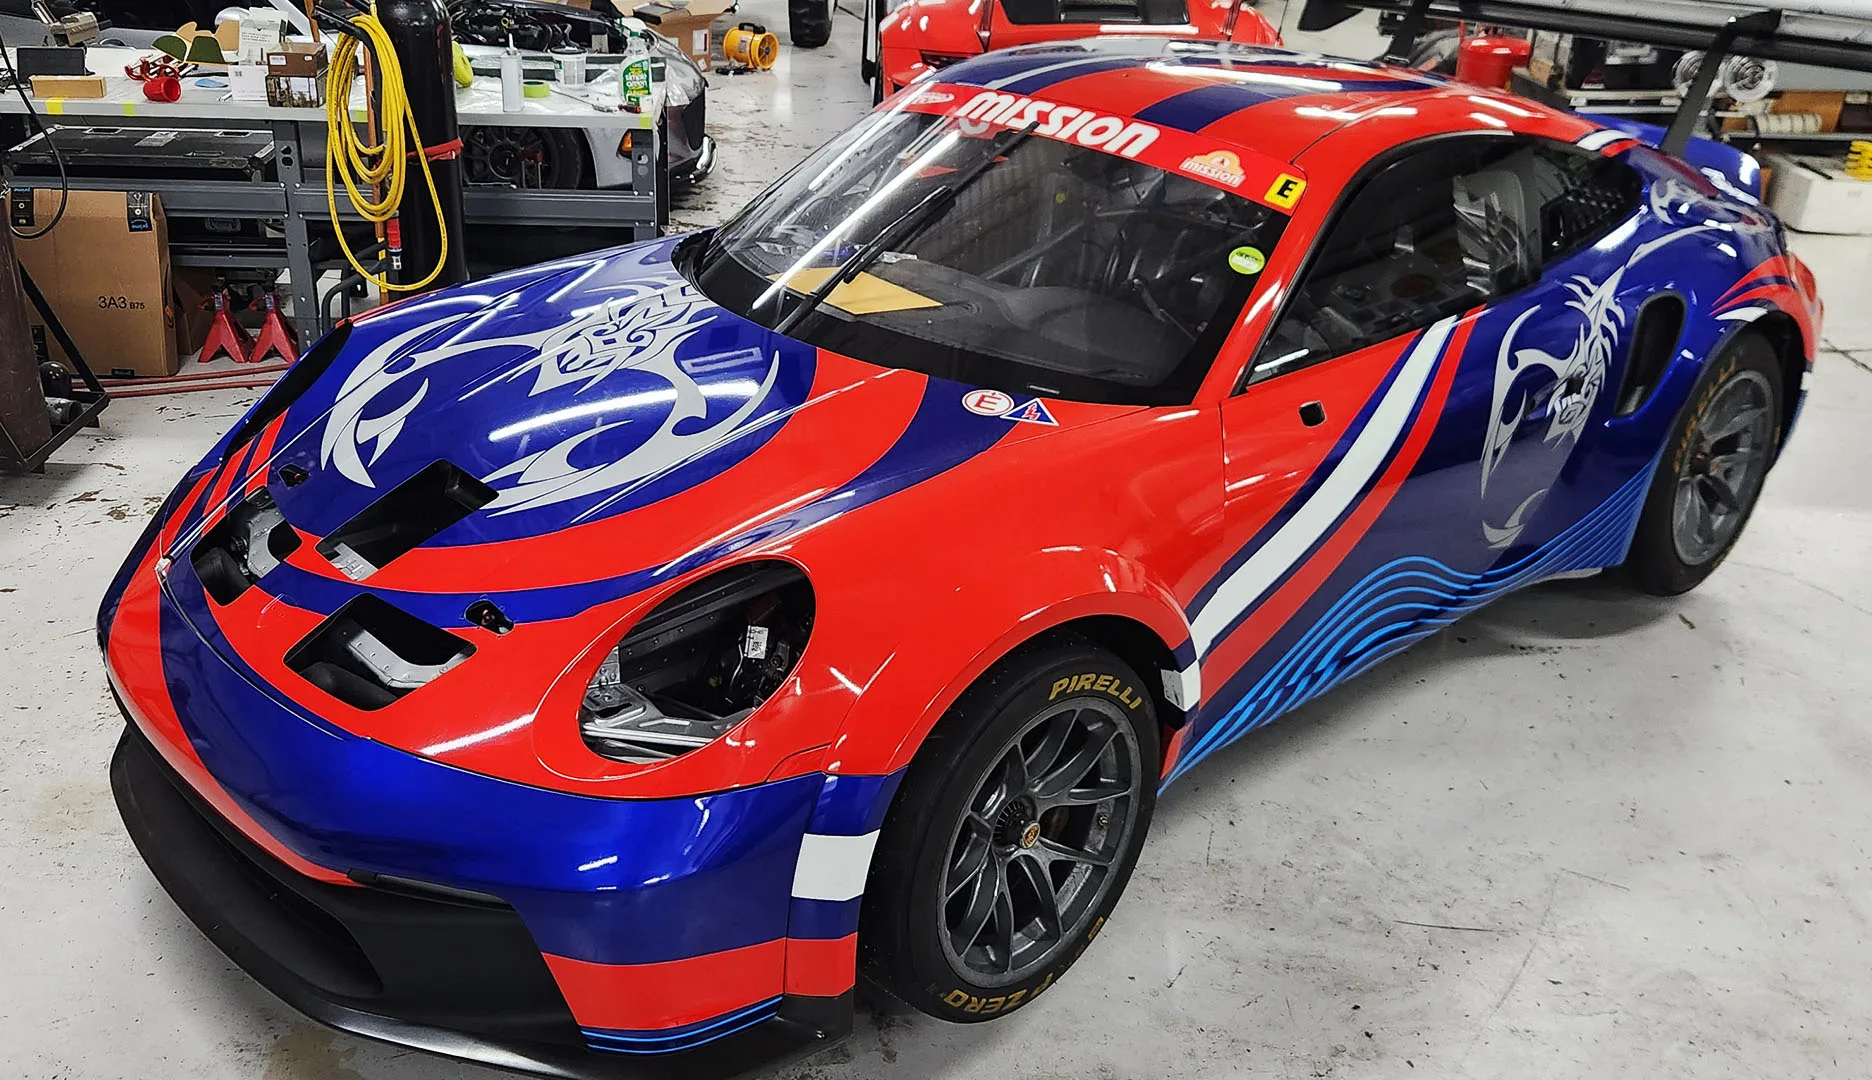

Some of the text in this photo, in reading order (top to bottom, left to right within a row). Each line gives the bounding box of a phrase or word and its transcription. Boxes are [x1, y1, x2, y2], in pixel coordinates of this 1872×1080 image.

[955, 91, 1161, 158] MISSION
[1181, 159, 1243, 186] mission
[1276, 178, 1299, 199] E
[98, 295, 146, 310] 3A3 B75
[1048, 673, 1142, 709] PIRELLI
[943, 988, 1028, 1015] ZERO
